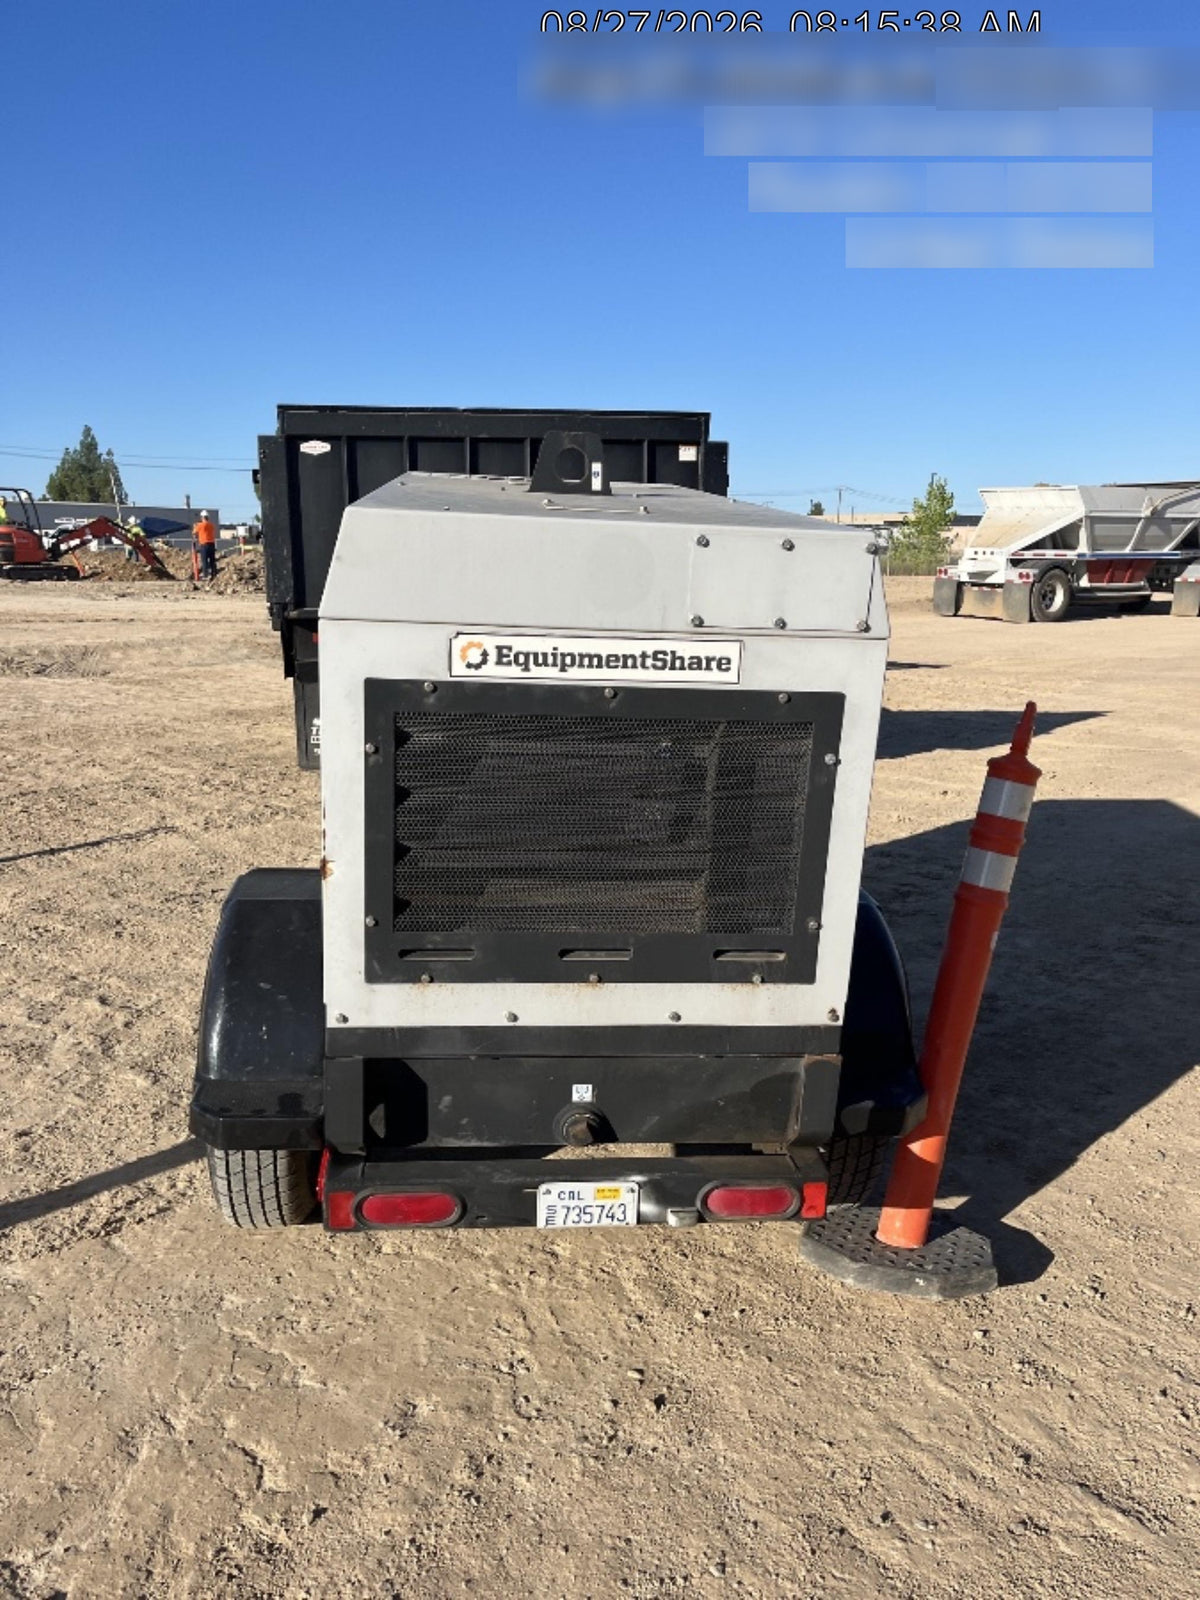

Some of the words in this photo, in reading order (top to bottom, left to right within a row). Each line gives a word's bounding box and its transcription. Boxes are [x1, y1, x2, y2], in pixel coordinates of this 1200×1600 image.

[494, 645, 732, 673] EquipmentShare
[557, 1190, 585, 1201] CAL
[561, 1203, 628, 1226] 735743
